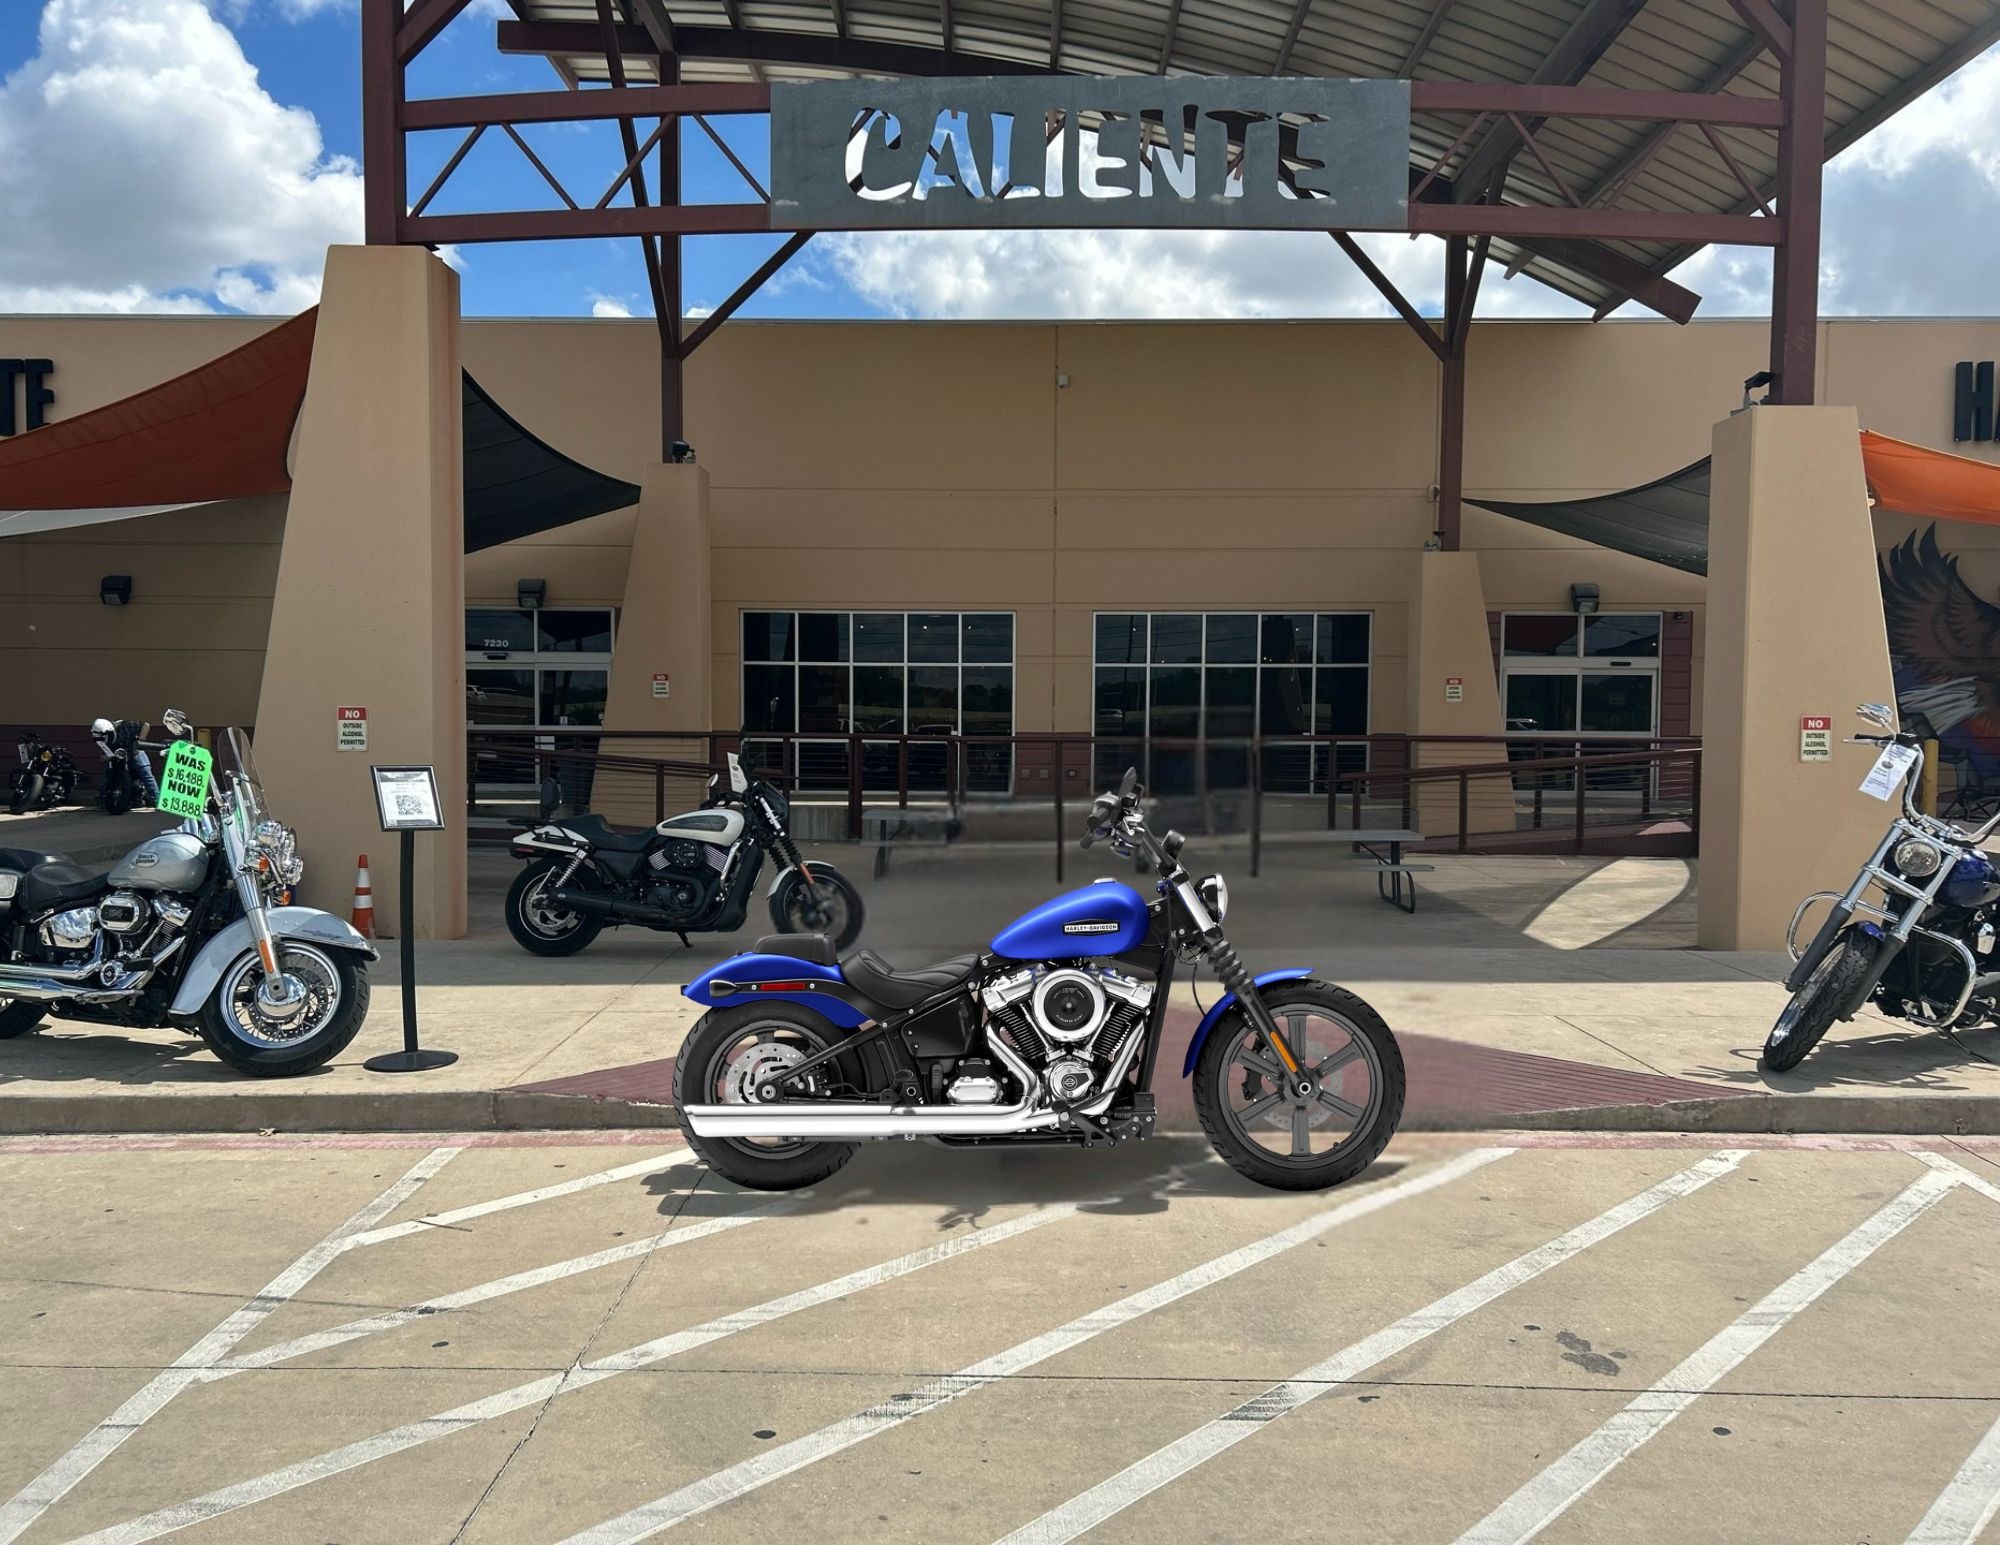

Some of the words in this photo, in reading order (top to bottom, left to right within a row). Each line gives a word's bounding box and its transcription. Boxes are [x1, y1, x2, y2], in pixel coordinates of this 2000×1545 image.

[845, 104, 1332, 200] CALIENTE
[1954, 361, 2000, 442] H
[483, 639, 509, 648] 7230
[344, 710, 360, 719] NO
[1807, 719, 1824, 729] NO
[175, 752, 206, 772] WAS
[167, 779, 201, 798] NOW
[1065, 924, 1117, 932] HARLEY-DAVIDSON
